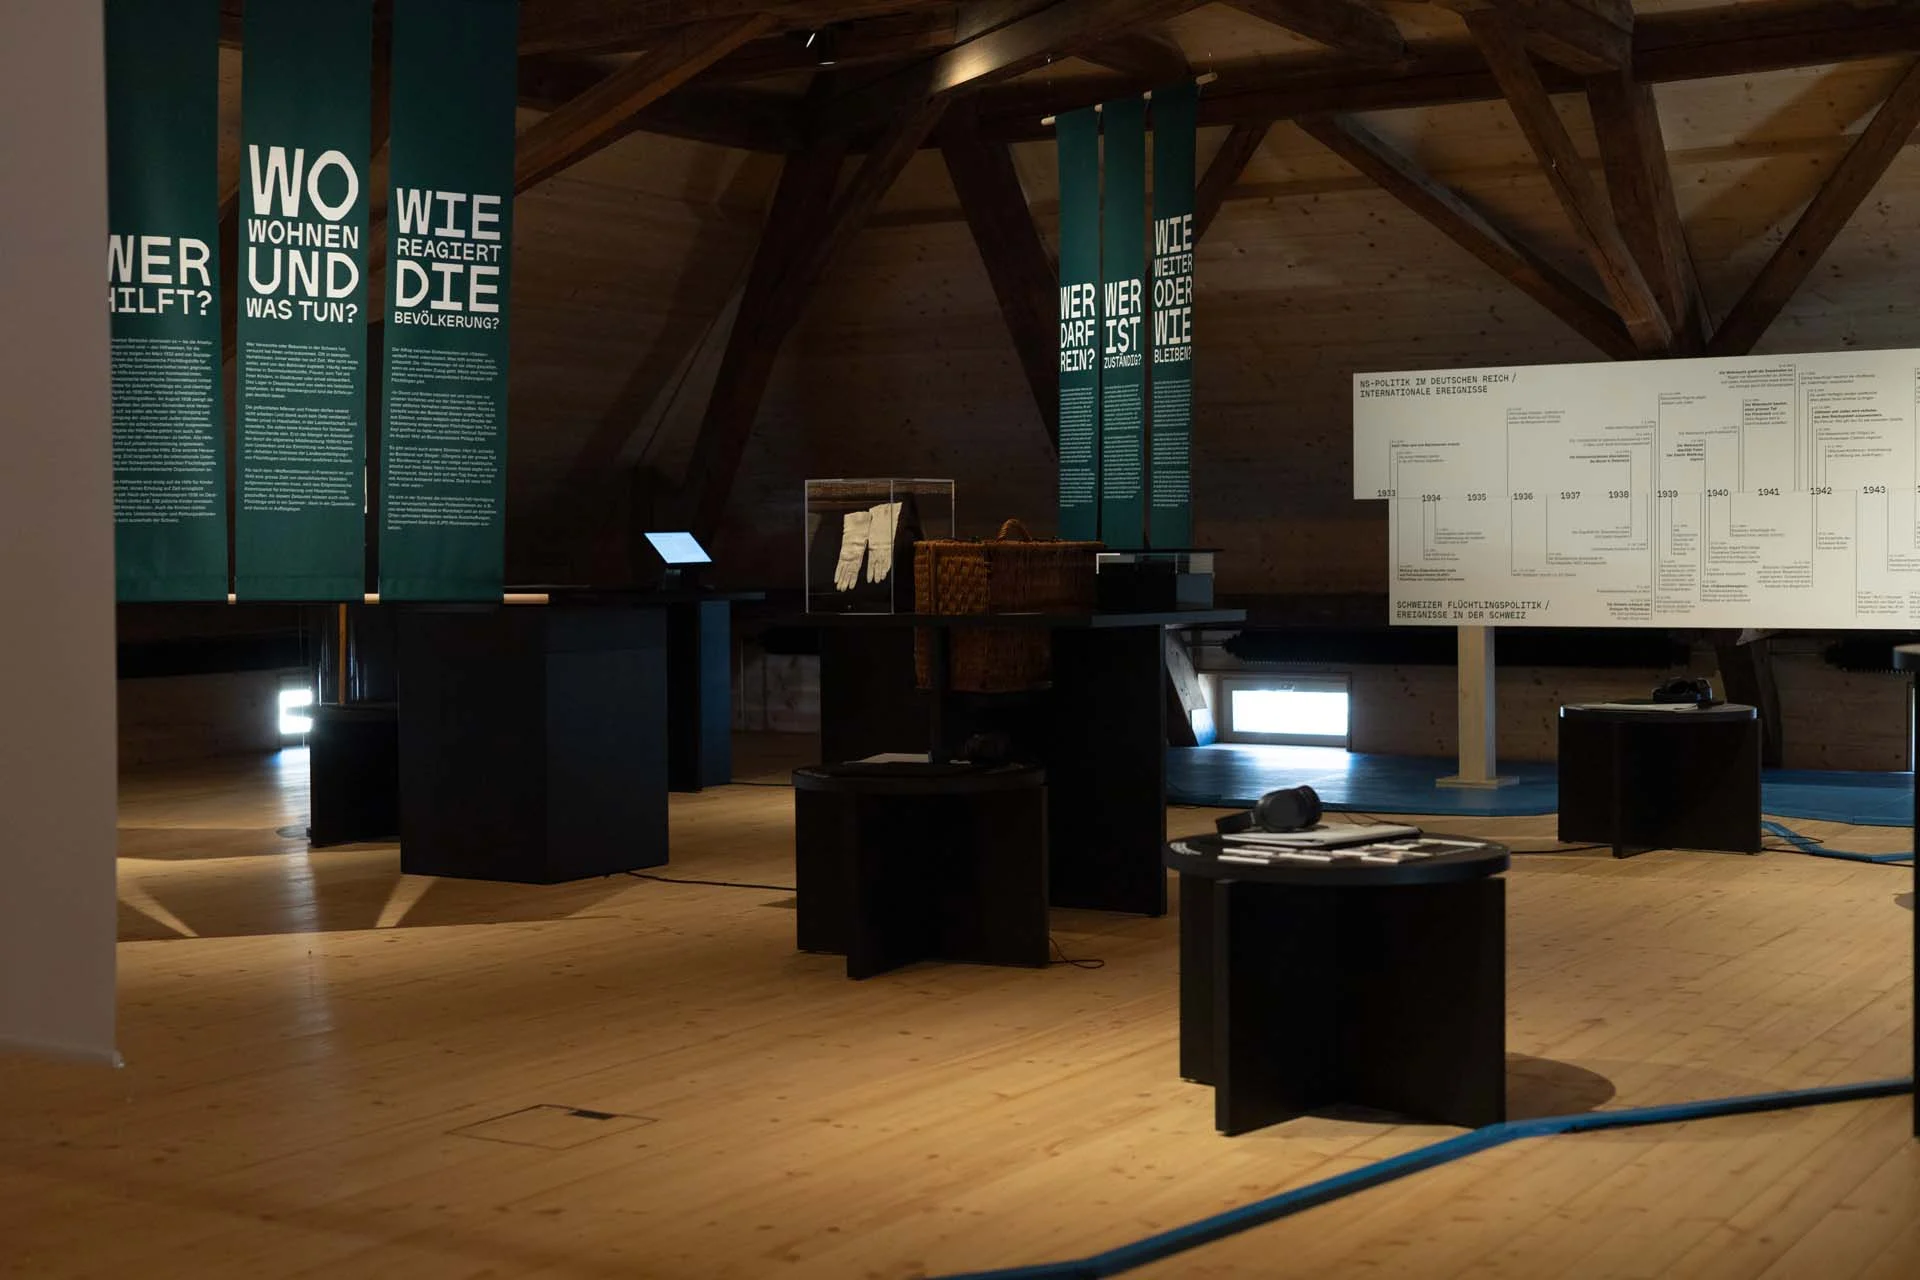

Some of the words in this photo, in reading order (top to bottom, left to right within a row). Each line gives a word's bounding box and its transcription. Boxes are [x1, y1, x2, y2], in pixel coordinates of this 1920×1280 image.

[249, 144, 359, 222] WO
[396, 187, 501, 240] WIE
[248, 219, 359, 249] WOHNEN
[1155, 213, 1193, 256] WIE
[108, 234, 211, 286] WER
[396, 238, 502, 263] REAGIERT
[1154, 254, 1193, 277] WEITER
[248, 246, 359, 299] UND
[396, 259, 500, 313] DIE
[1060, 283, 1096, 320] WER
[1104, 278, 1142, 317] WER
[1154, 275, 1193, 309] ODER
[246, 297, 293, 320] WAS
[298, 301, 359, 323] TUN?
[394, 311, 500, 330] BEVÖLKERUNG?
[1060, 319, 1096, 349] DARF
[1105, 316, 1141, 354] IST
[1154, 306, 1192, 346] WIE
[1060, 348, 1096, 373] REIN?
[1104, 353, 1142, 369] ZUSTÄNDIG?
[1154, 346, 1192, 363] BLEIBEN?
[1360, 379, 1411, 388] NS-POLITIK
[1415, 377, 1427, 385] IM
[1431, 375, 1478, 385] DEUTSCHEN
[1482, 374, 1509, 383] REICH
[1360, 387, 1431, 398] INTERNATIONALE
[1436, 385, 1488, 395] EREIGNISSE
[1377, 489, 1396, 497] 1933
[1422, 494, 1441, 502] 1934
[1467, 493, 1487, 501] 1935
[1513, 493, 1533, 501] 1936
[1561, 491, 1581, 500] 1937
[1608, 490, 1630, 499] 1938
[1657, 490, 1678, 498] 1939
[1707, 489, 1729, 497] 1940
[1758, 488, 1780, 496] 1941
[1810, 487, 1833, 495] 1942
[1863, 486, 1886, 495] 1943
[1397, 601, 1442, 609] SCHWEIZER
[1447, 600, 1542, 609] FLÜCHTLINGSPOLITIK
[1397, 610, 1447, 619] EREIGNISSE
[1453, 610, 1463, 618] IN
[1468, 610, 1484, 619] DER
[1489, 610, 1526, 619] SCHWEIZ
